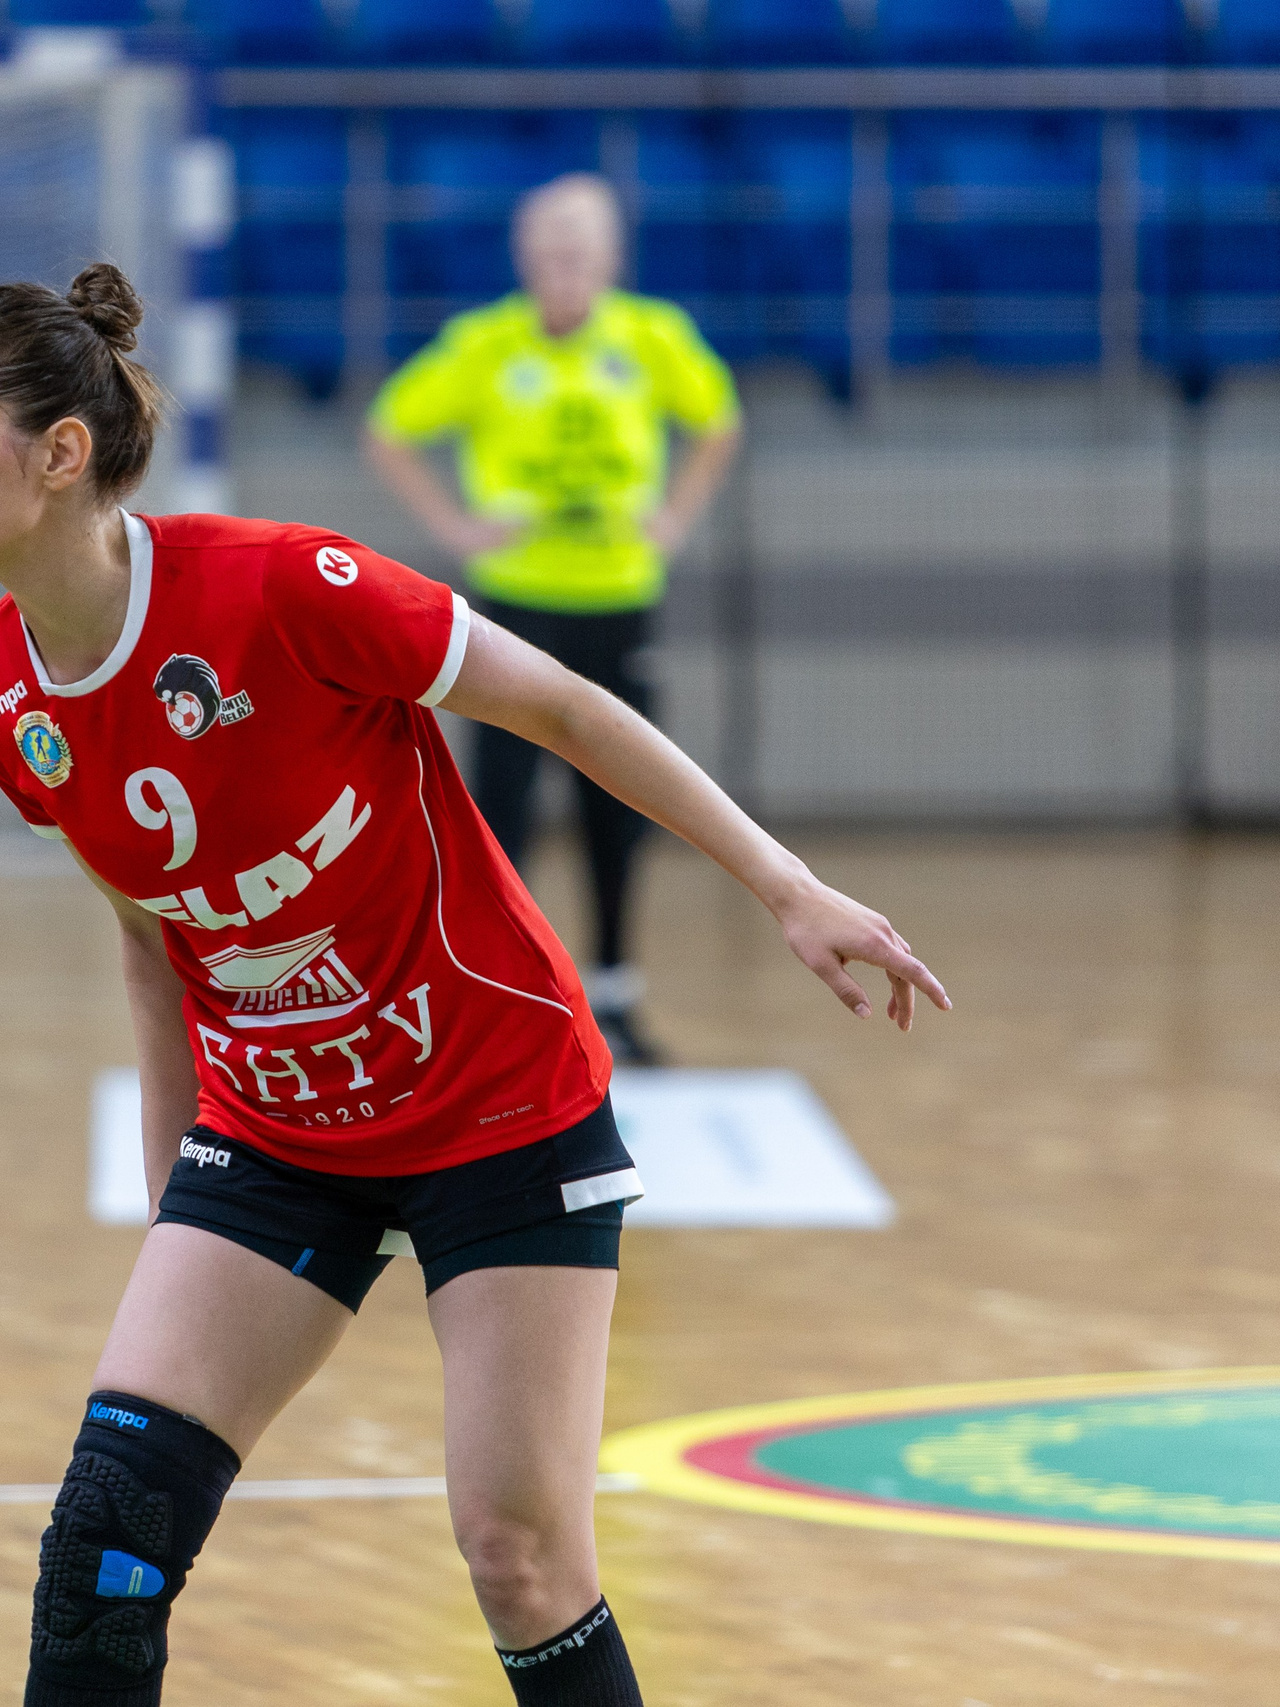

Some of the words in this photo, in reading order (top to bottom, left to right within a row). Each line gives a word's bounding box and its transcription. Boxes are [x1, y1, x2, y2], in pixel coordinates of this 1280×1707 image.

[221, 691, 249, 712] BNTU
[221, 702, 251, 725] BELAZ
[124, 766, 198, 872] 9
[126, 784, 372, 931] ELAZ
[478, 1114, 501, 1125] 2face
[502, 1109, 515, 1118] dry
[516, 1103, 535, 1114] tech
[179, 1135, 232, 1168] Kempa
[87, 1401, 150, 1431] Kempa
[501, 1606, 610, 1669] Kempa
